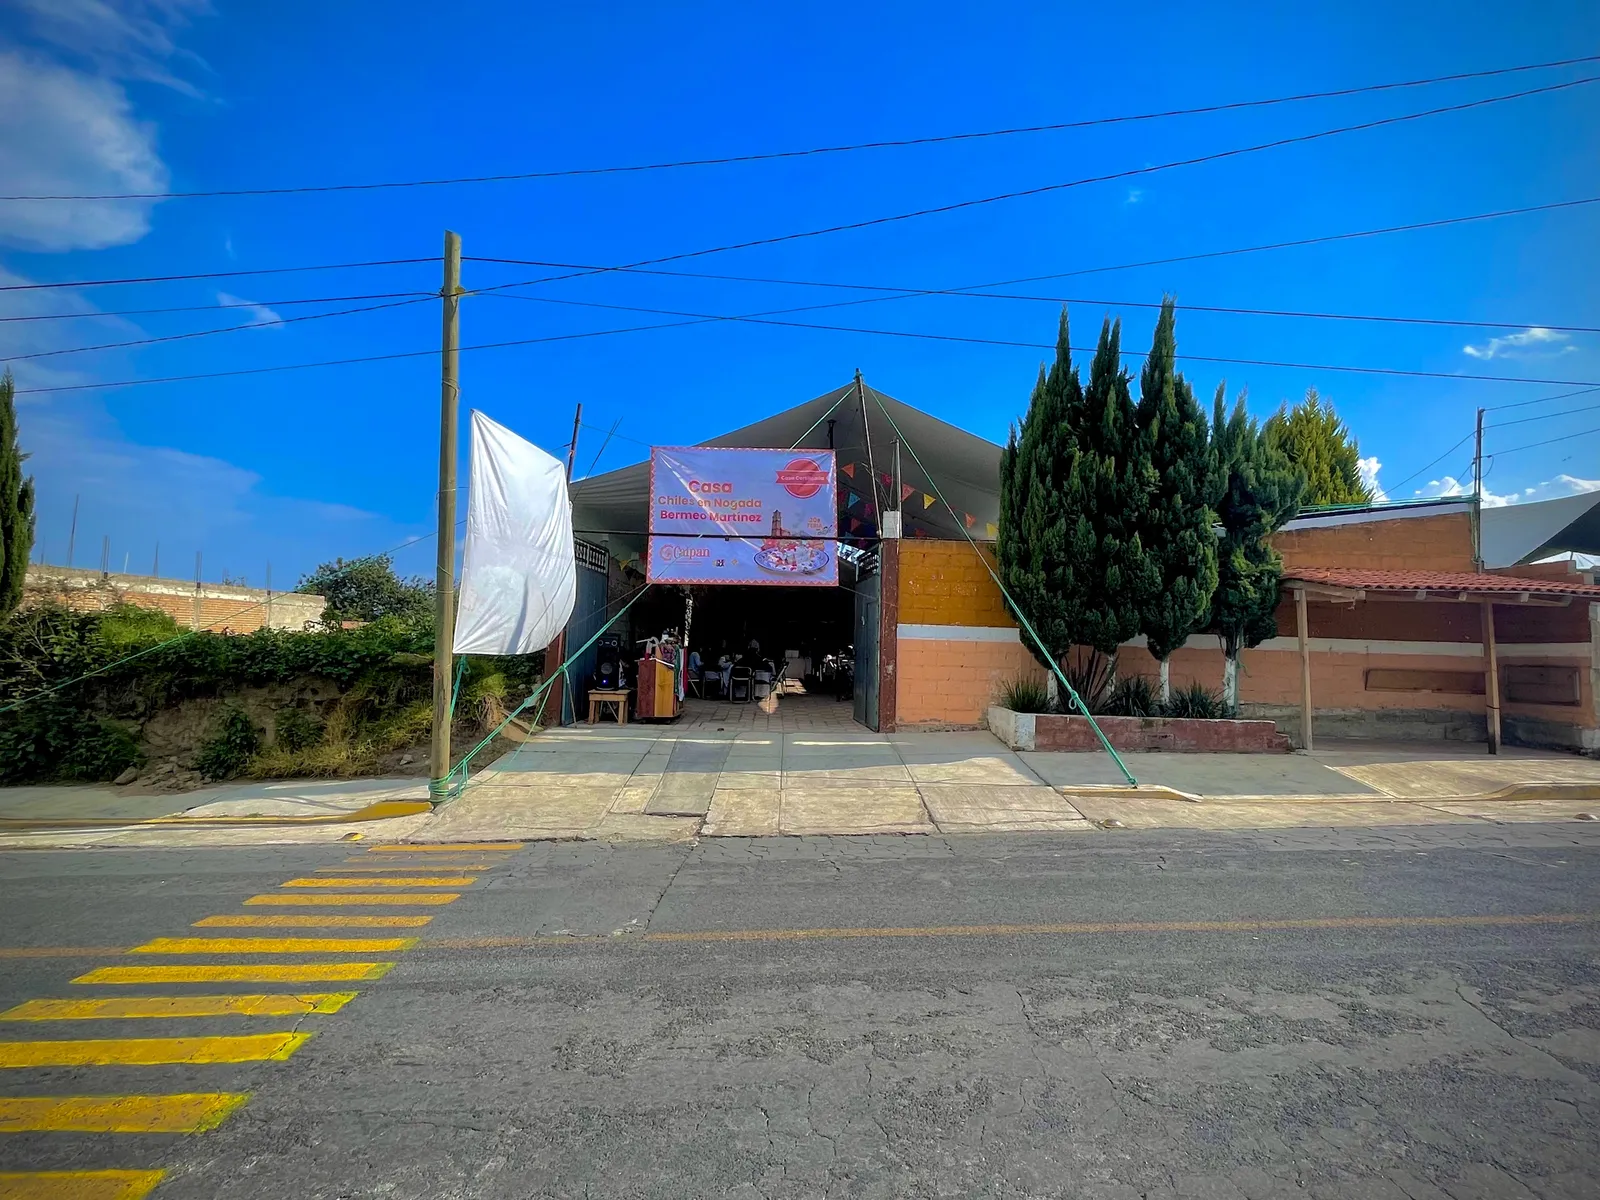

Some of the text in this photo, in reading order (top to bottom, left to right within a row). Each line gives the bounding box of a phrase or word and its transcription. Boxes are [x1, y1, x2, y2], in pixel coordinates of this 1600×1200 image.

[688, 480, 733, 493] Casa
[658, 495, 762, 510] Chiles en Nogada
[660, 510, 762, 522] Bermeo Martínez
